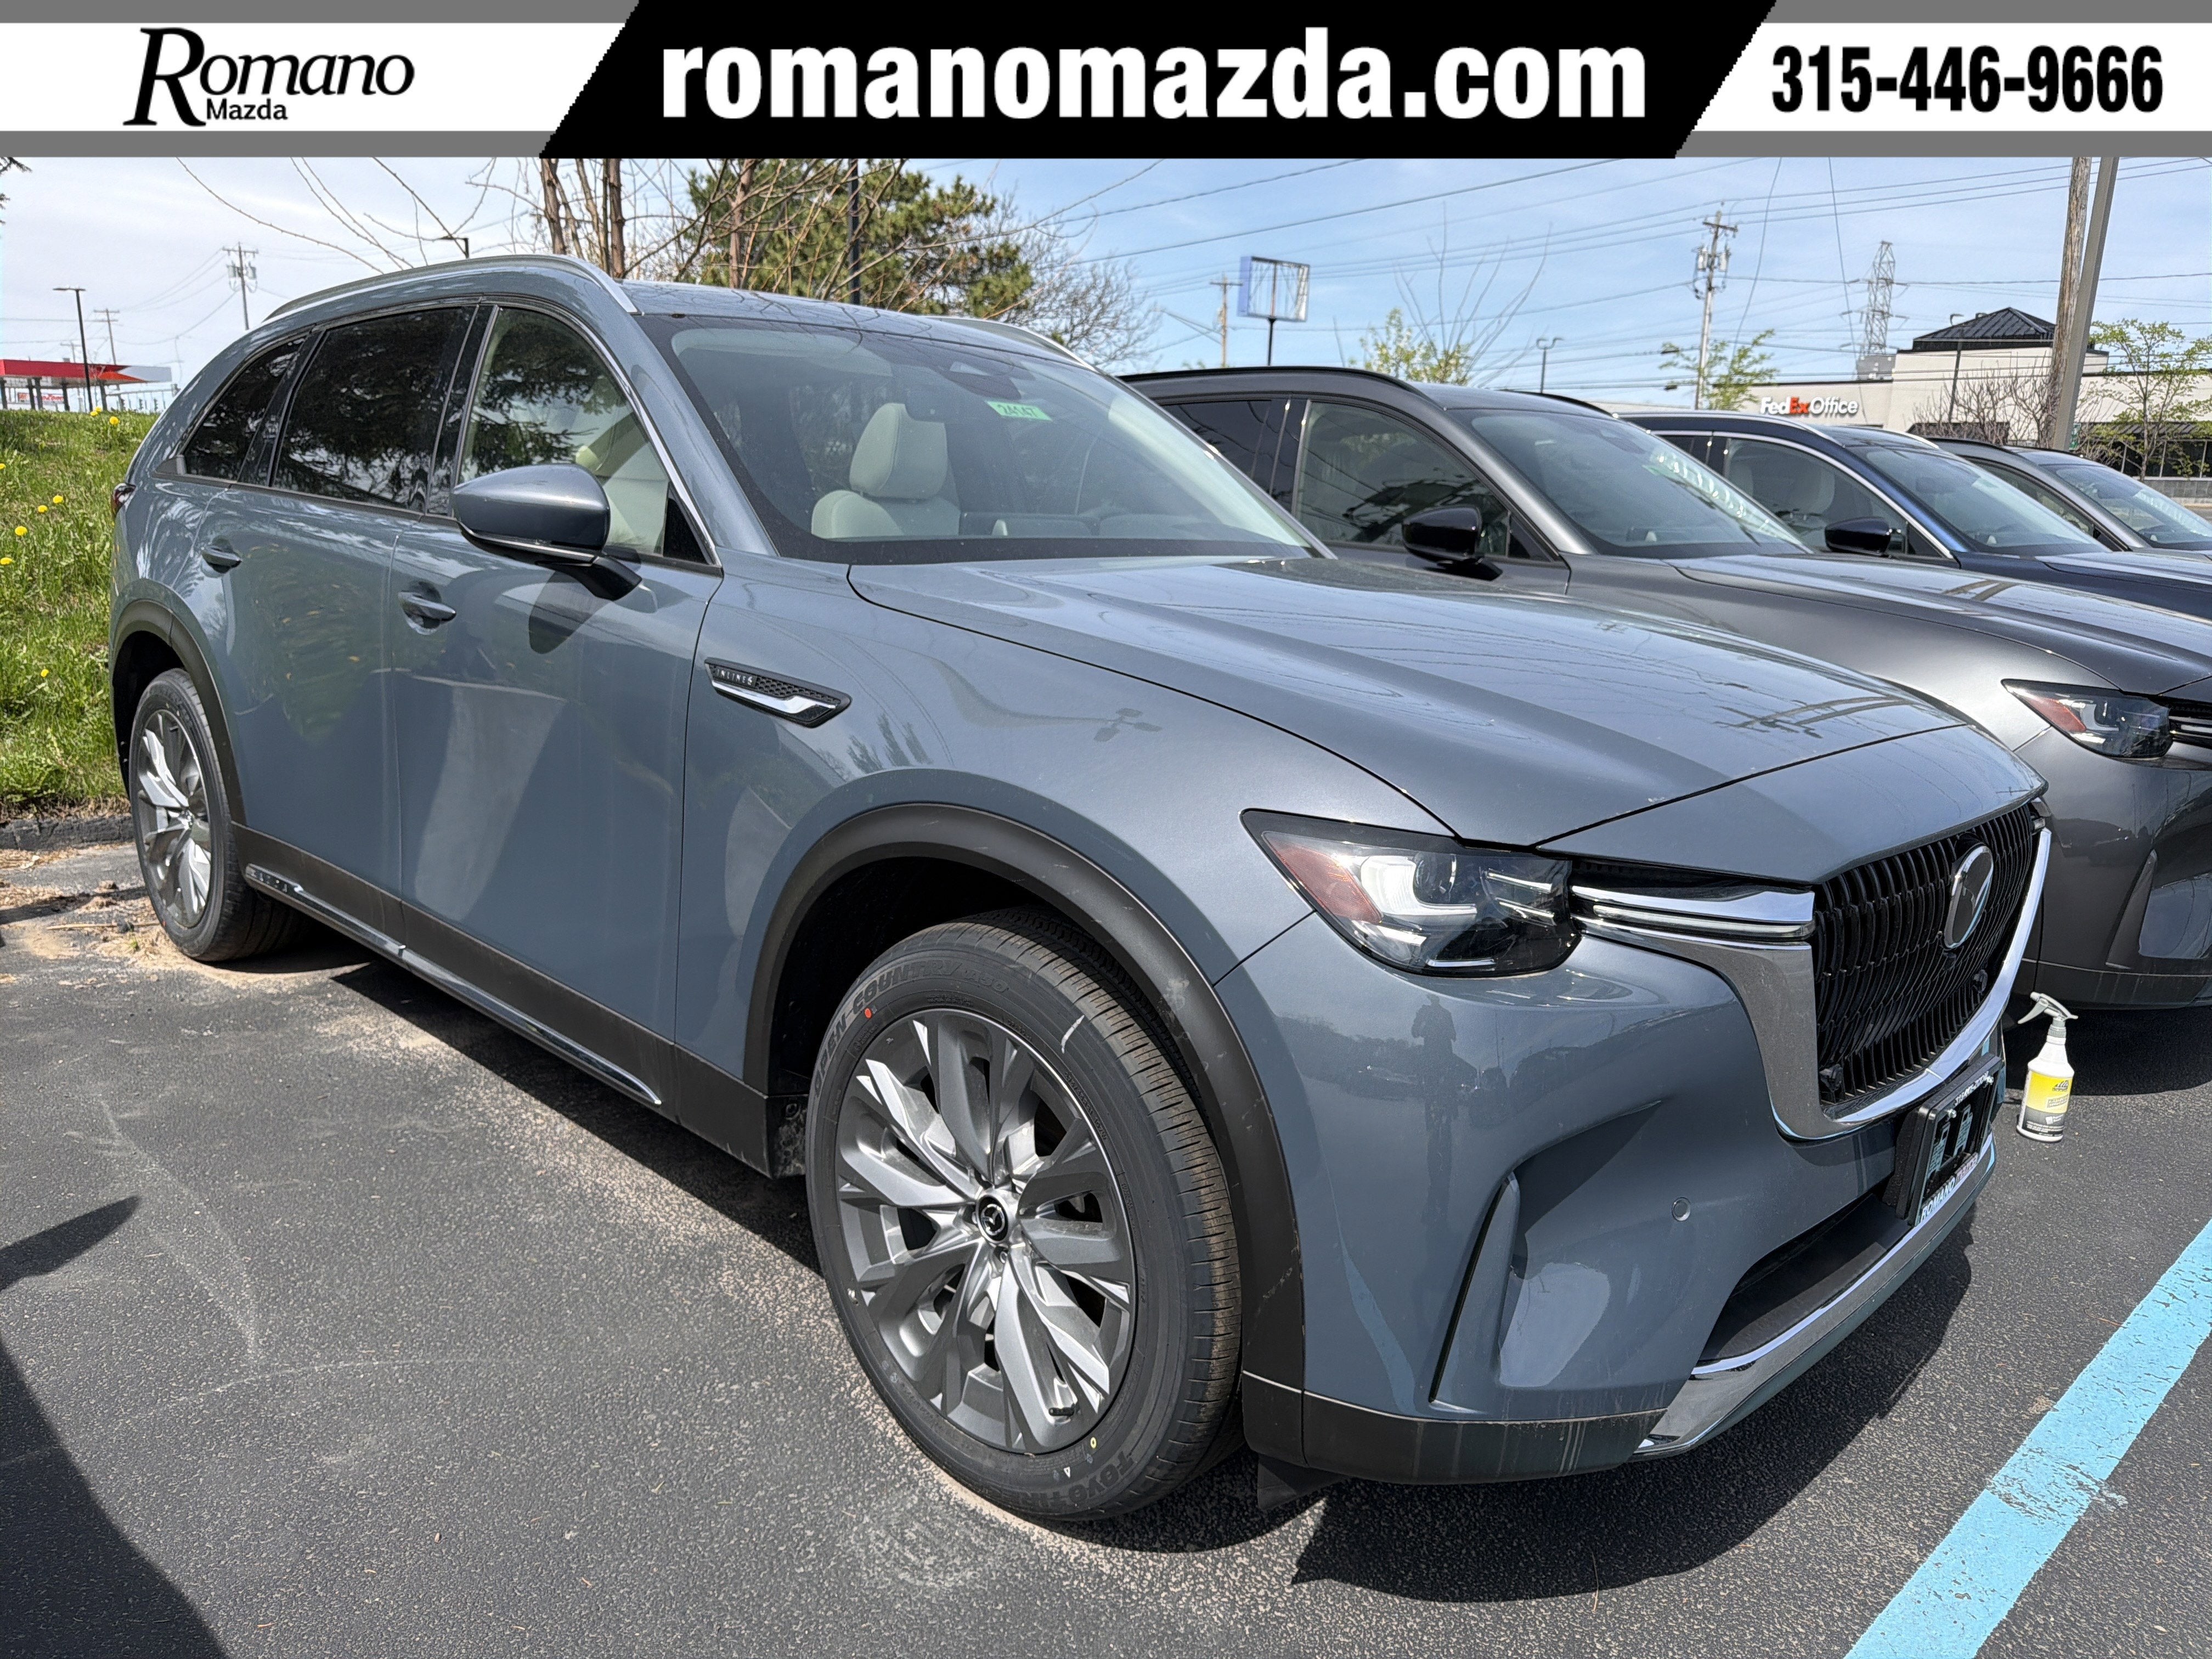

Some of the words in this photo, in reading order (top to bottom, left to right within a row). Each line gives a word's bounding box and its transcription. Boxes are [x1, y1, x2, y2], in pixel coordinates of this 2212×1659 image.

[1760, 396, 1810, 415] FedEx
[1811, 396, 1858, 415] Office
[1920, 1177, 1955, 1222] ROMANO
[1069, 1451, 1135, 1503] TOYO
